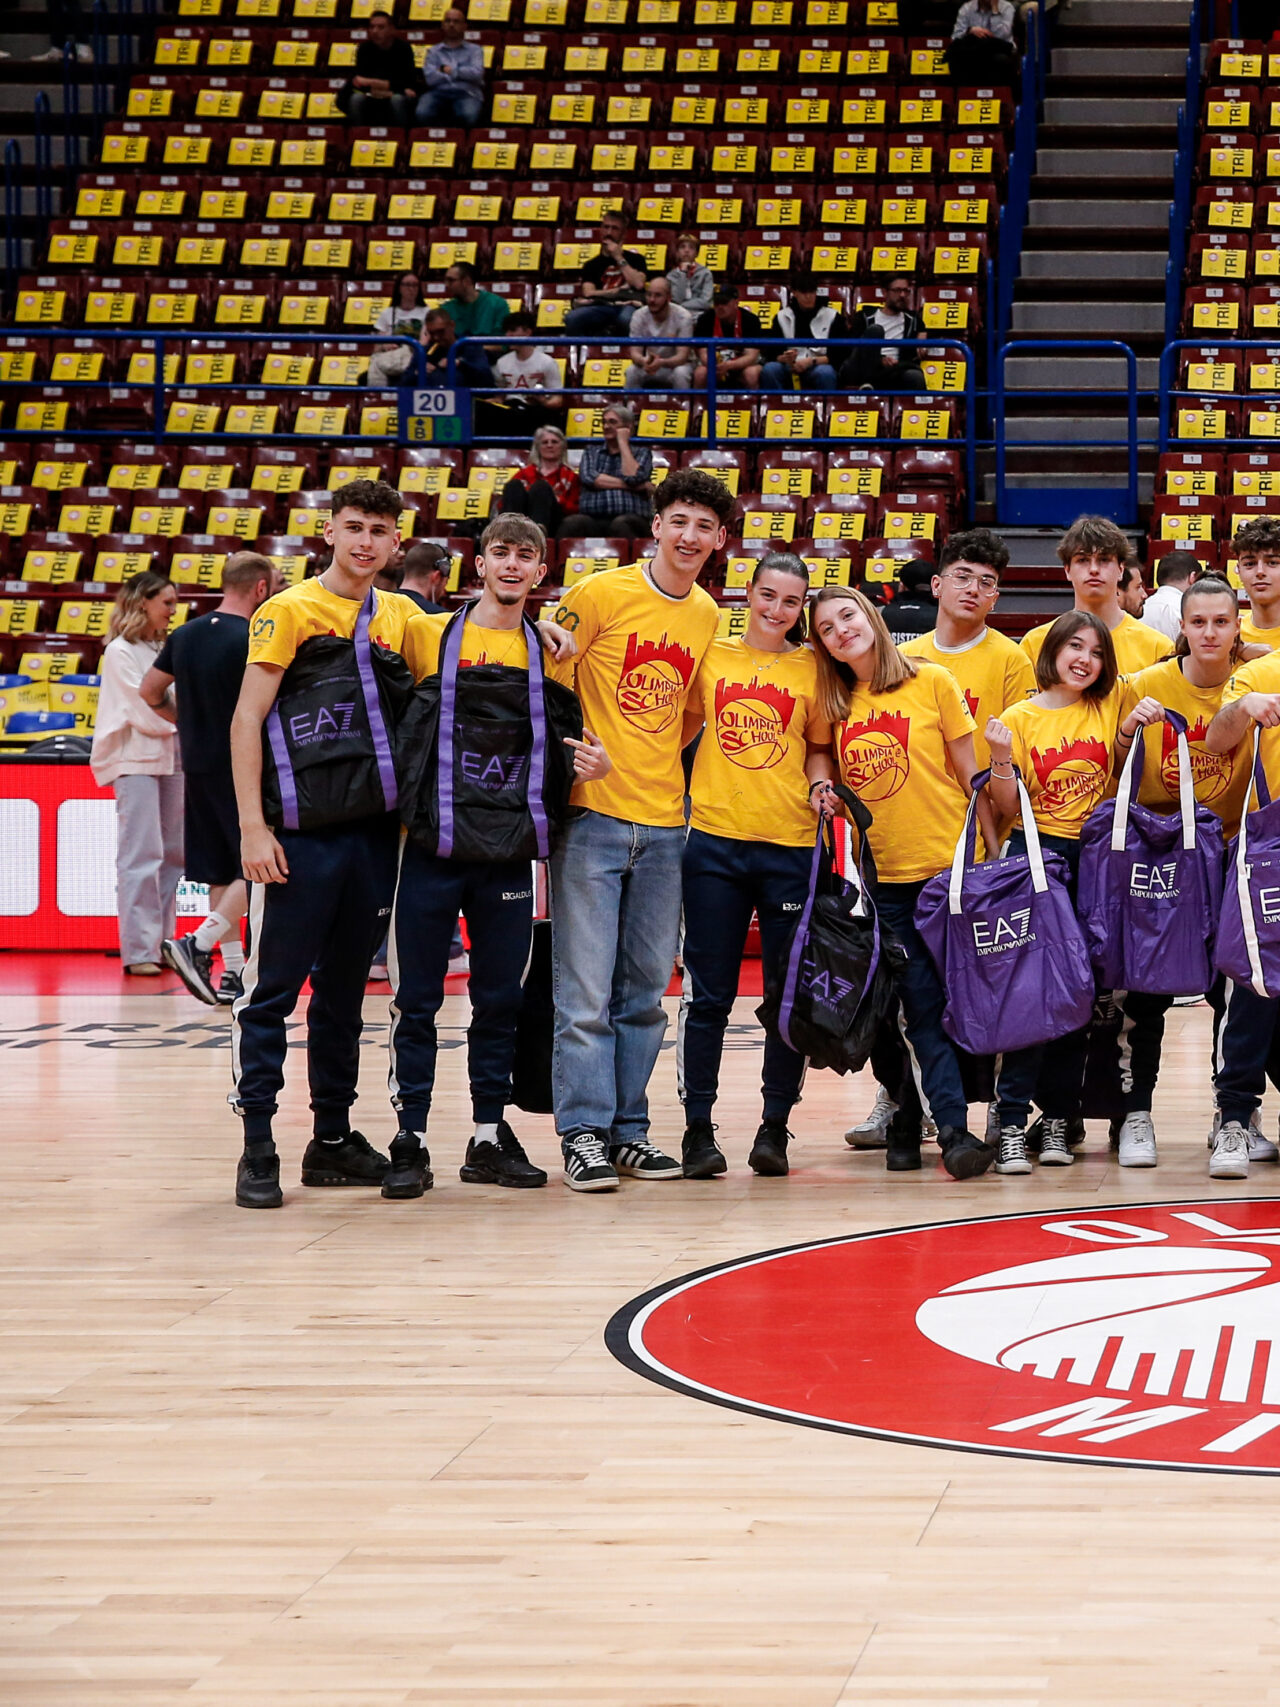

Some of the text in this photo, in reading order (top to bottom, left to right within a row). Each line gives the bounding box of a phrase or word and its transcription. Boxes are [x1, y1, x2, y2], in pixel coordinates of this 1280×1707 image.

[419, 393, 446, 412] 20
[415, 428, 425, 439] B
[290, 702, 355, 741] EA7
[720, 712, 775, 731] OLIMPIA
[720, 730, 778, 751] SCHOOL
[461, 751, 526, 783] EA7
[844, 748, 893, 766] OLIMPIA
[1167, 755, 1218, 769] OIMPIA
[847, 758, 897, 787] SCHOOL
[1130, 862, 1177, 891] EA7
[973, 907, 1031, 948] EA7
[801, 959, 856, 1004] EA7
